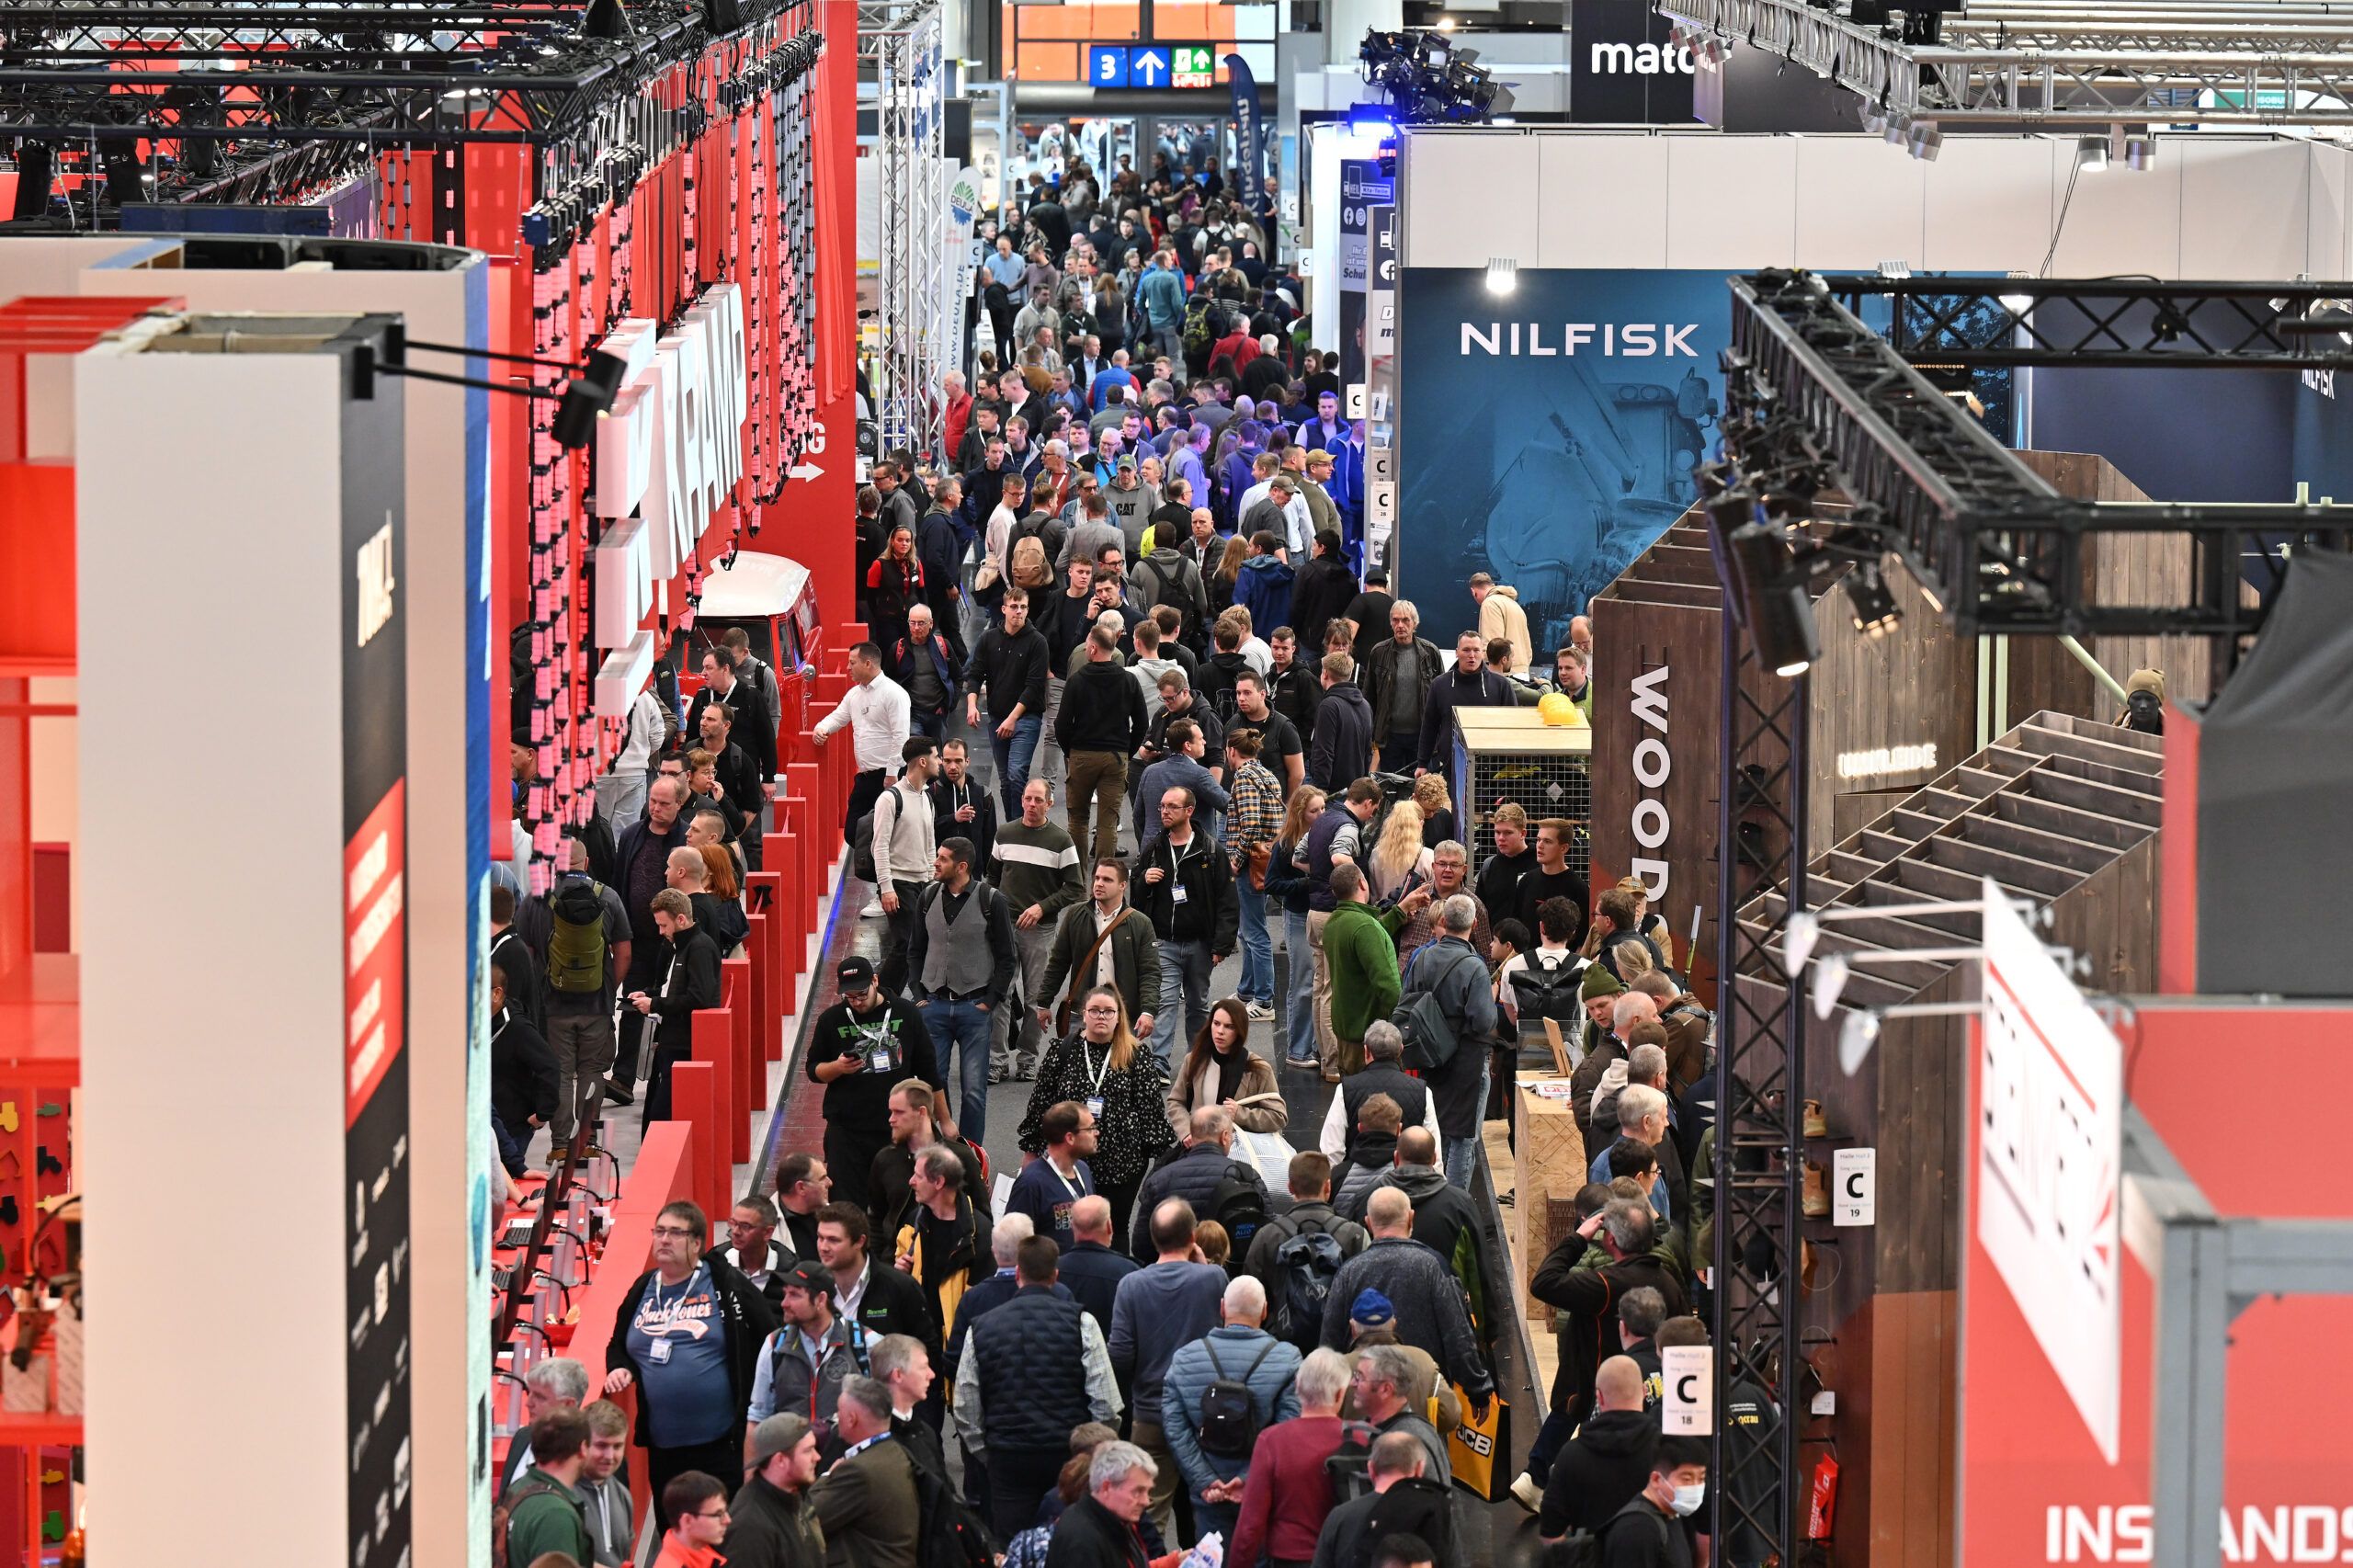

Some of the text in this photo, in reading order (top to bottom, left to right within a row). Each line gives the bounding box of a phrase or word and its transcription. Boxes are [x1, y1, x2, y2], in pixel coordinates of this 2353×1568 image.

[1101, 54, 1116, 80] 3
[950, 195, 972, 212] DEULA
[1290, 203, 1295, 211] C
[1293, 234, 1300, 244] C
[972, 247, 980, 256] C
[1302, 257, 1309, 267] C
[1461, 323, 1699, 357] NILFISK
[1352, 394, 1361, 407] C
[639, 283, 747, 582] KRAMP
[1376, 460, 1386, 473] C
[1379, 493, 1389, 507] C
[1115, 503, 1136, 517] CAT
[1846, 1173, 1864, 1199] C
[1850, 1209, 1860, 1218] 19
[1677, 1374, 1698, 1403] C
[1681, 1415, 1693, 1426] 18
[1456, 1426, 1492, 1456] JCB
